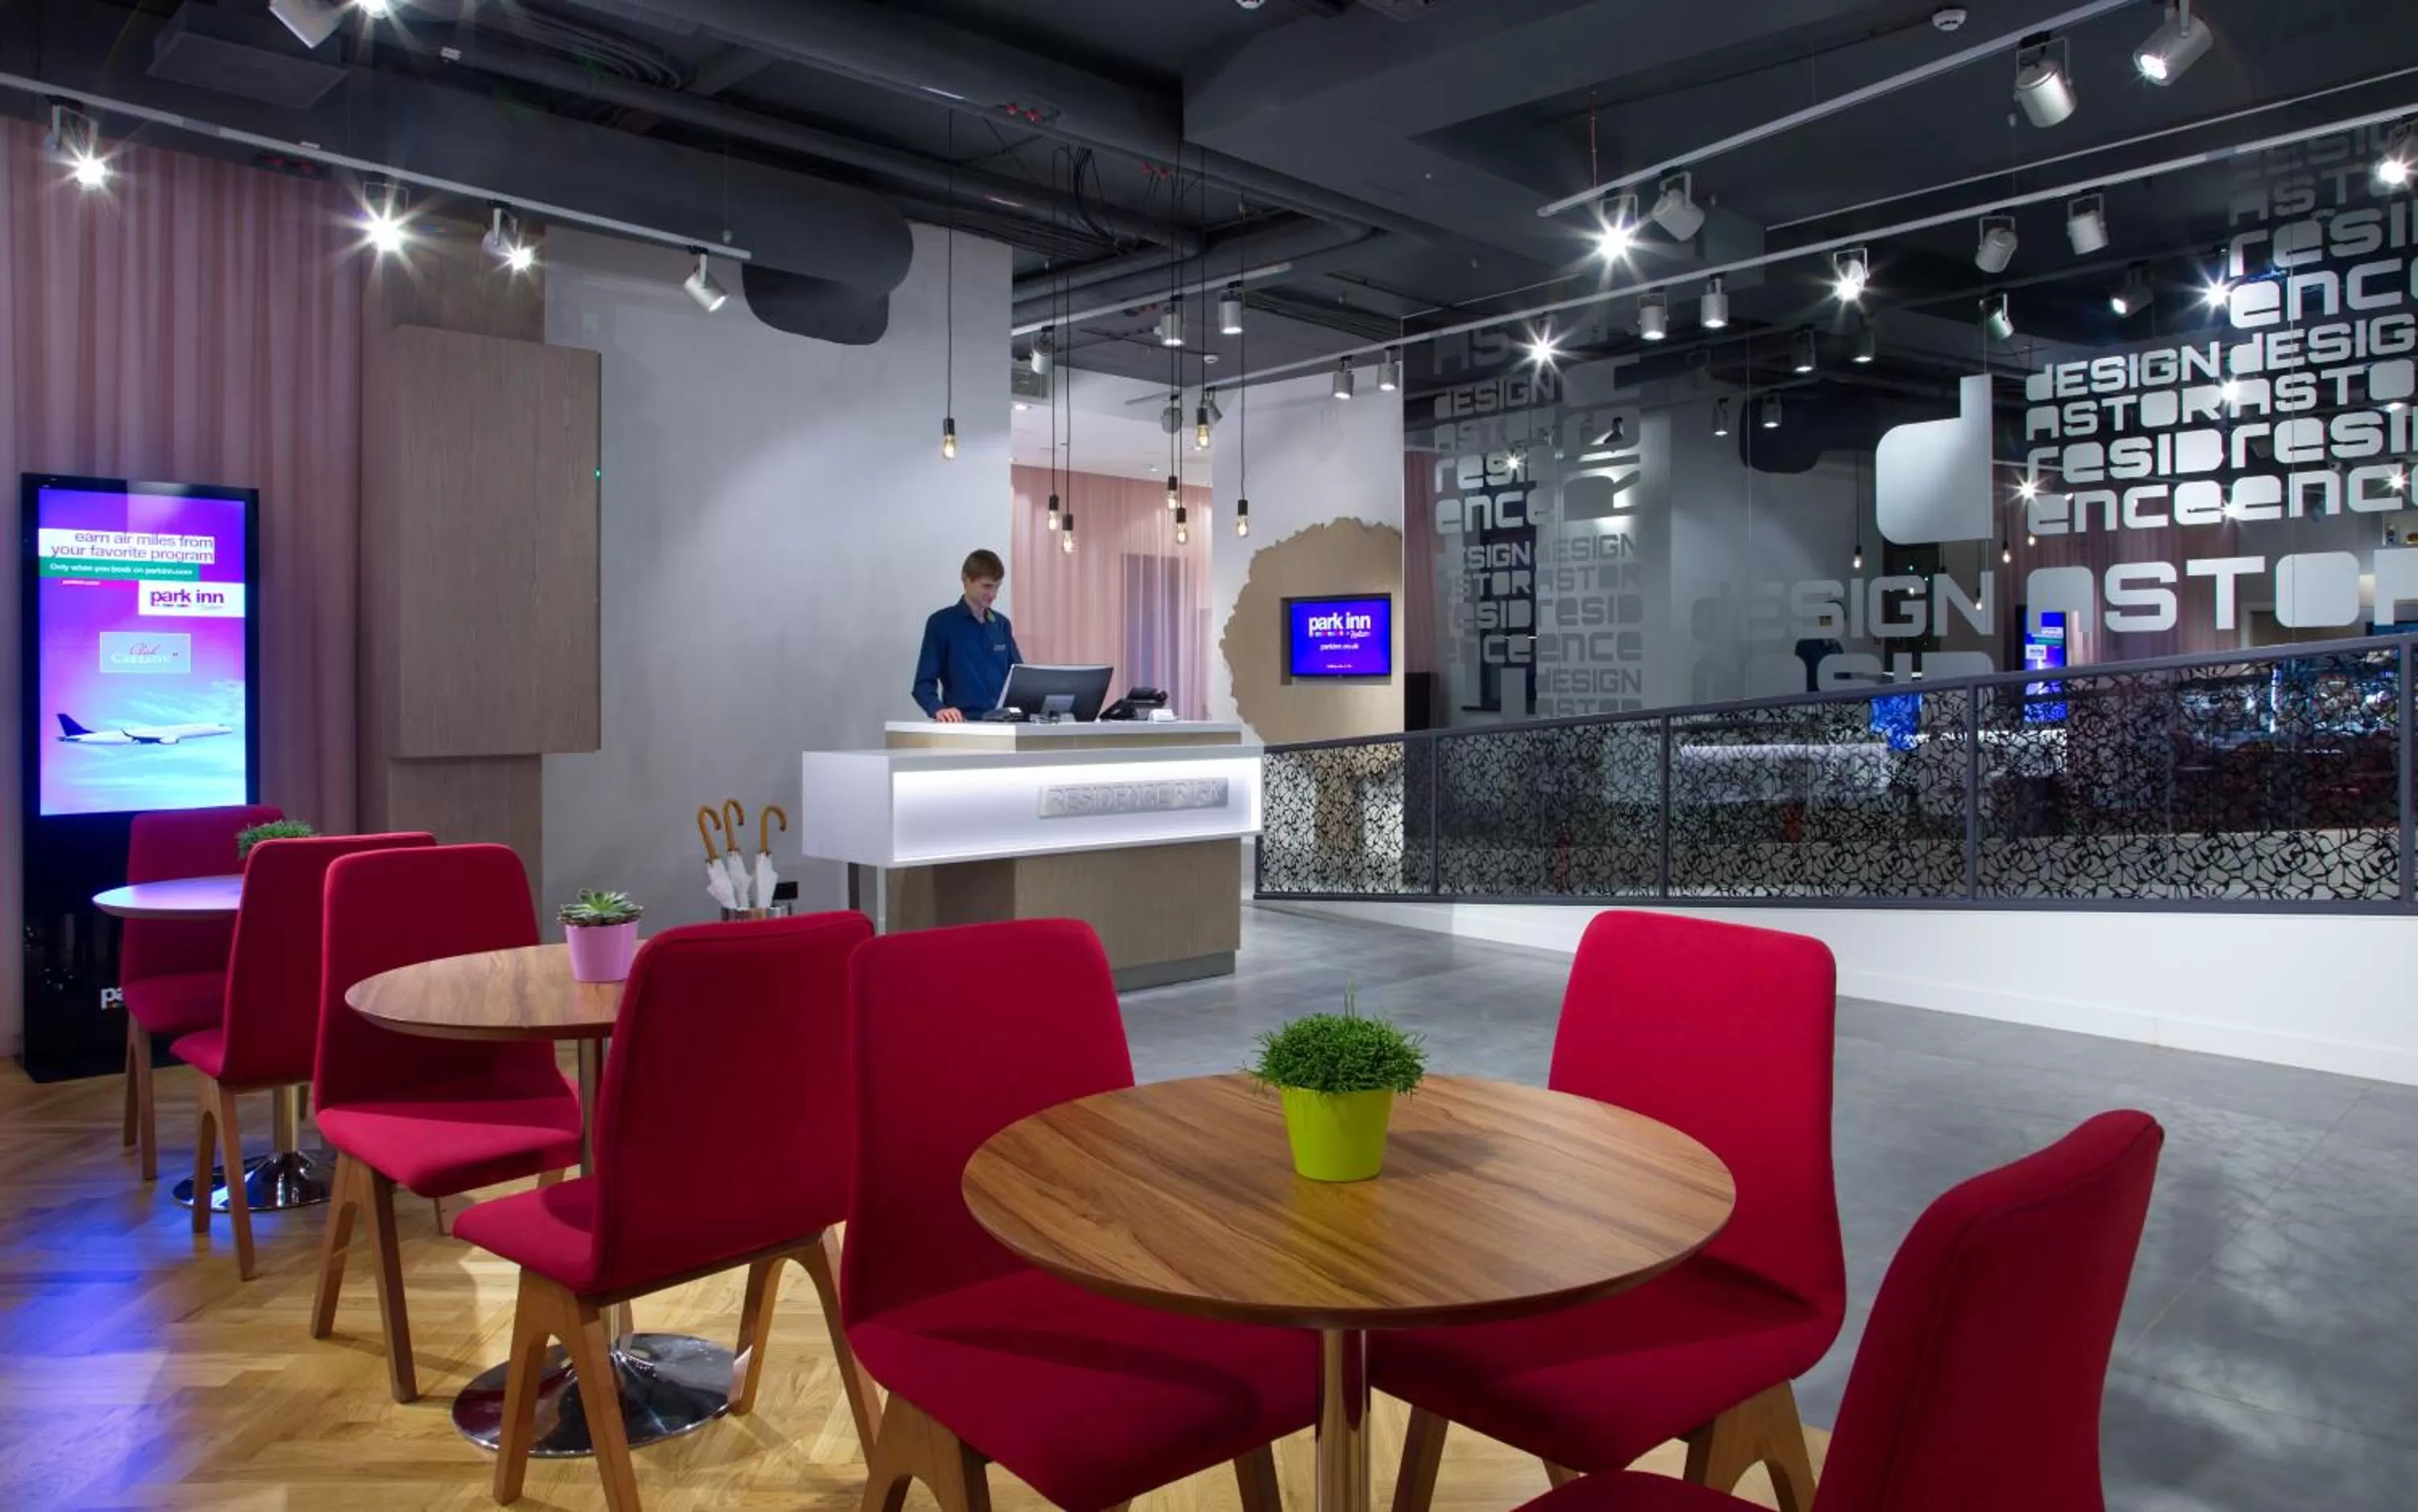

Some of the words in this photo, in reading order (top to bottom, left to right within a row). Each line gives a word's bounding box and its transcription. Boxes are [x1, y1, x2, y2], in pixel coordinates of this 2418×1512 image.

[2231, 256, 2418, 329] enc
[2231, 463, 2418, 520] enc
[75, 532, 110, 545] earn
[114, 532, 132, 545] air
[137, 534, 176, 547] miles
[178, 534, 214, 549] from
[52, 545, 86, 559] your
[90, 543, 147, 558] favorite
[151, 547, 214, 563] program
[49, 562, 69, 571] Only
[94, 565, 110, 573] you
[111, 565, 131, 573] book
[150, 588, 192, 607] park
[197, 589, 225, 604] inn
[1309, 612, 1344, 638] park
[1345, 612, 1371, 629] inn
